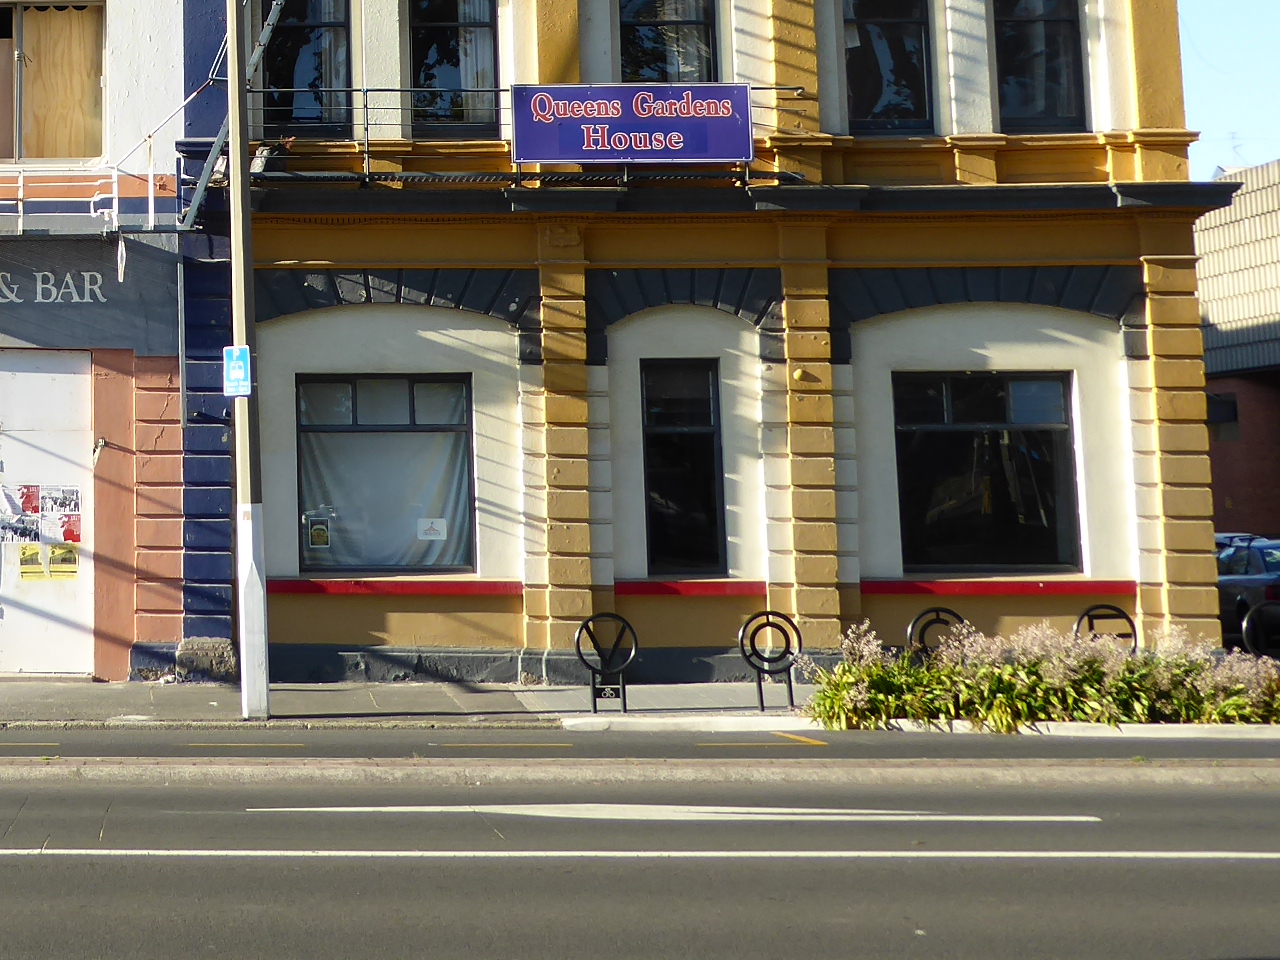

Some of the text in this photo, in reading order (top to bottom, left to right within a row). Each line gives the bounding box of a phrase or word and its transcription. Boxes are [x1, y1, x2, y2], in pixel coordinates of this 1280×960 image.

[531, 90, 732, 122] Queens Gardens
[581, 124, 683, 150] House
[32, 270, 108, 304] BAR
